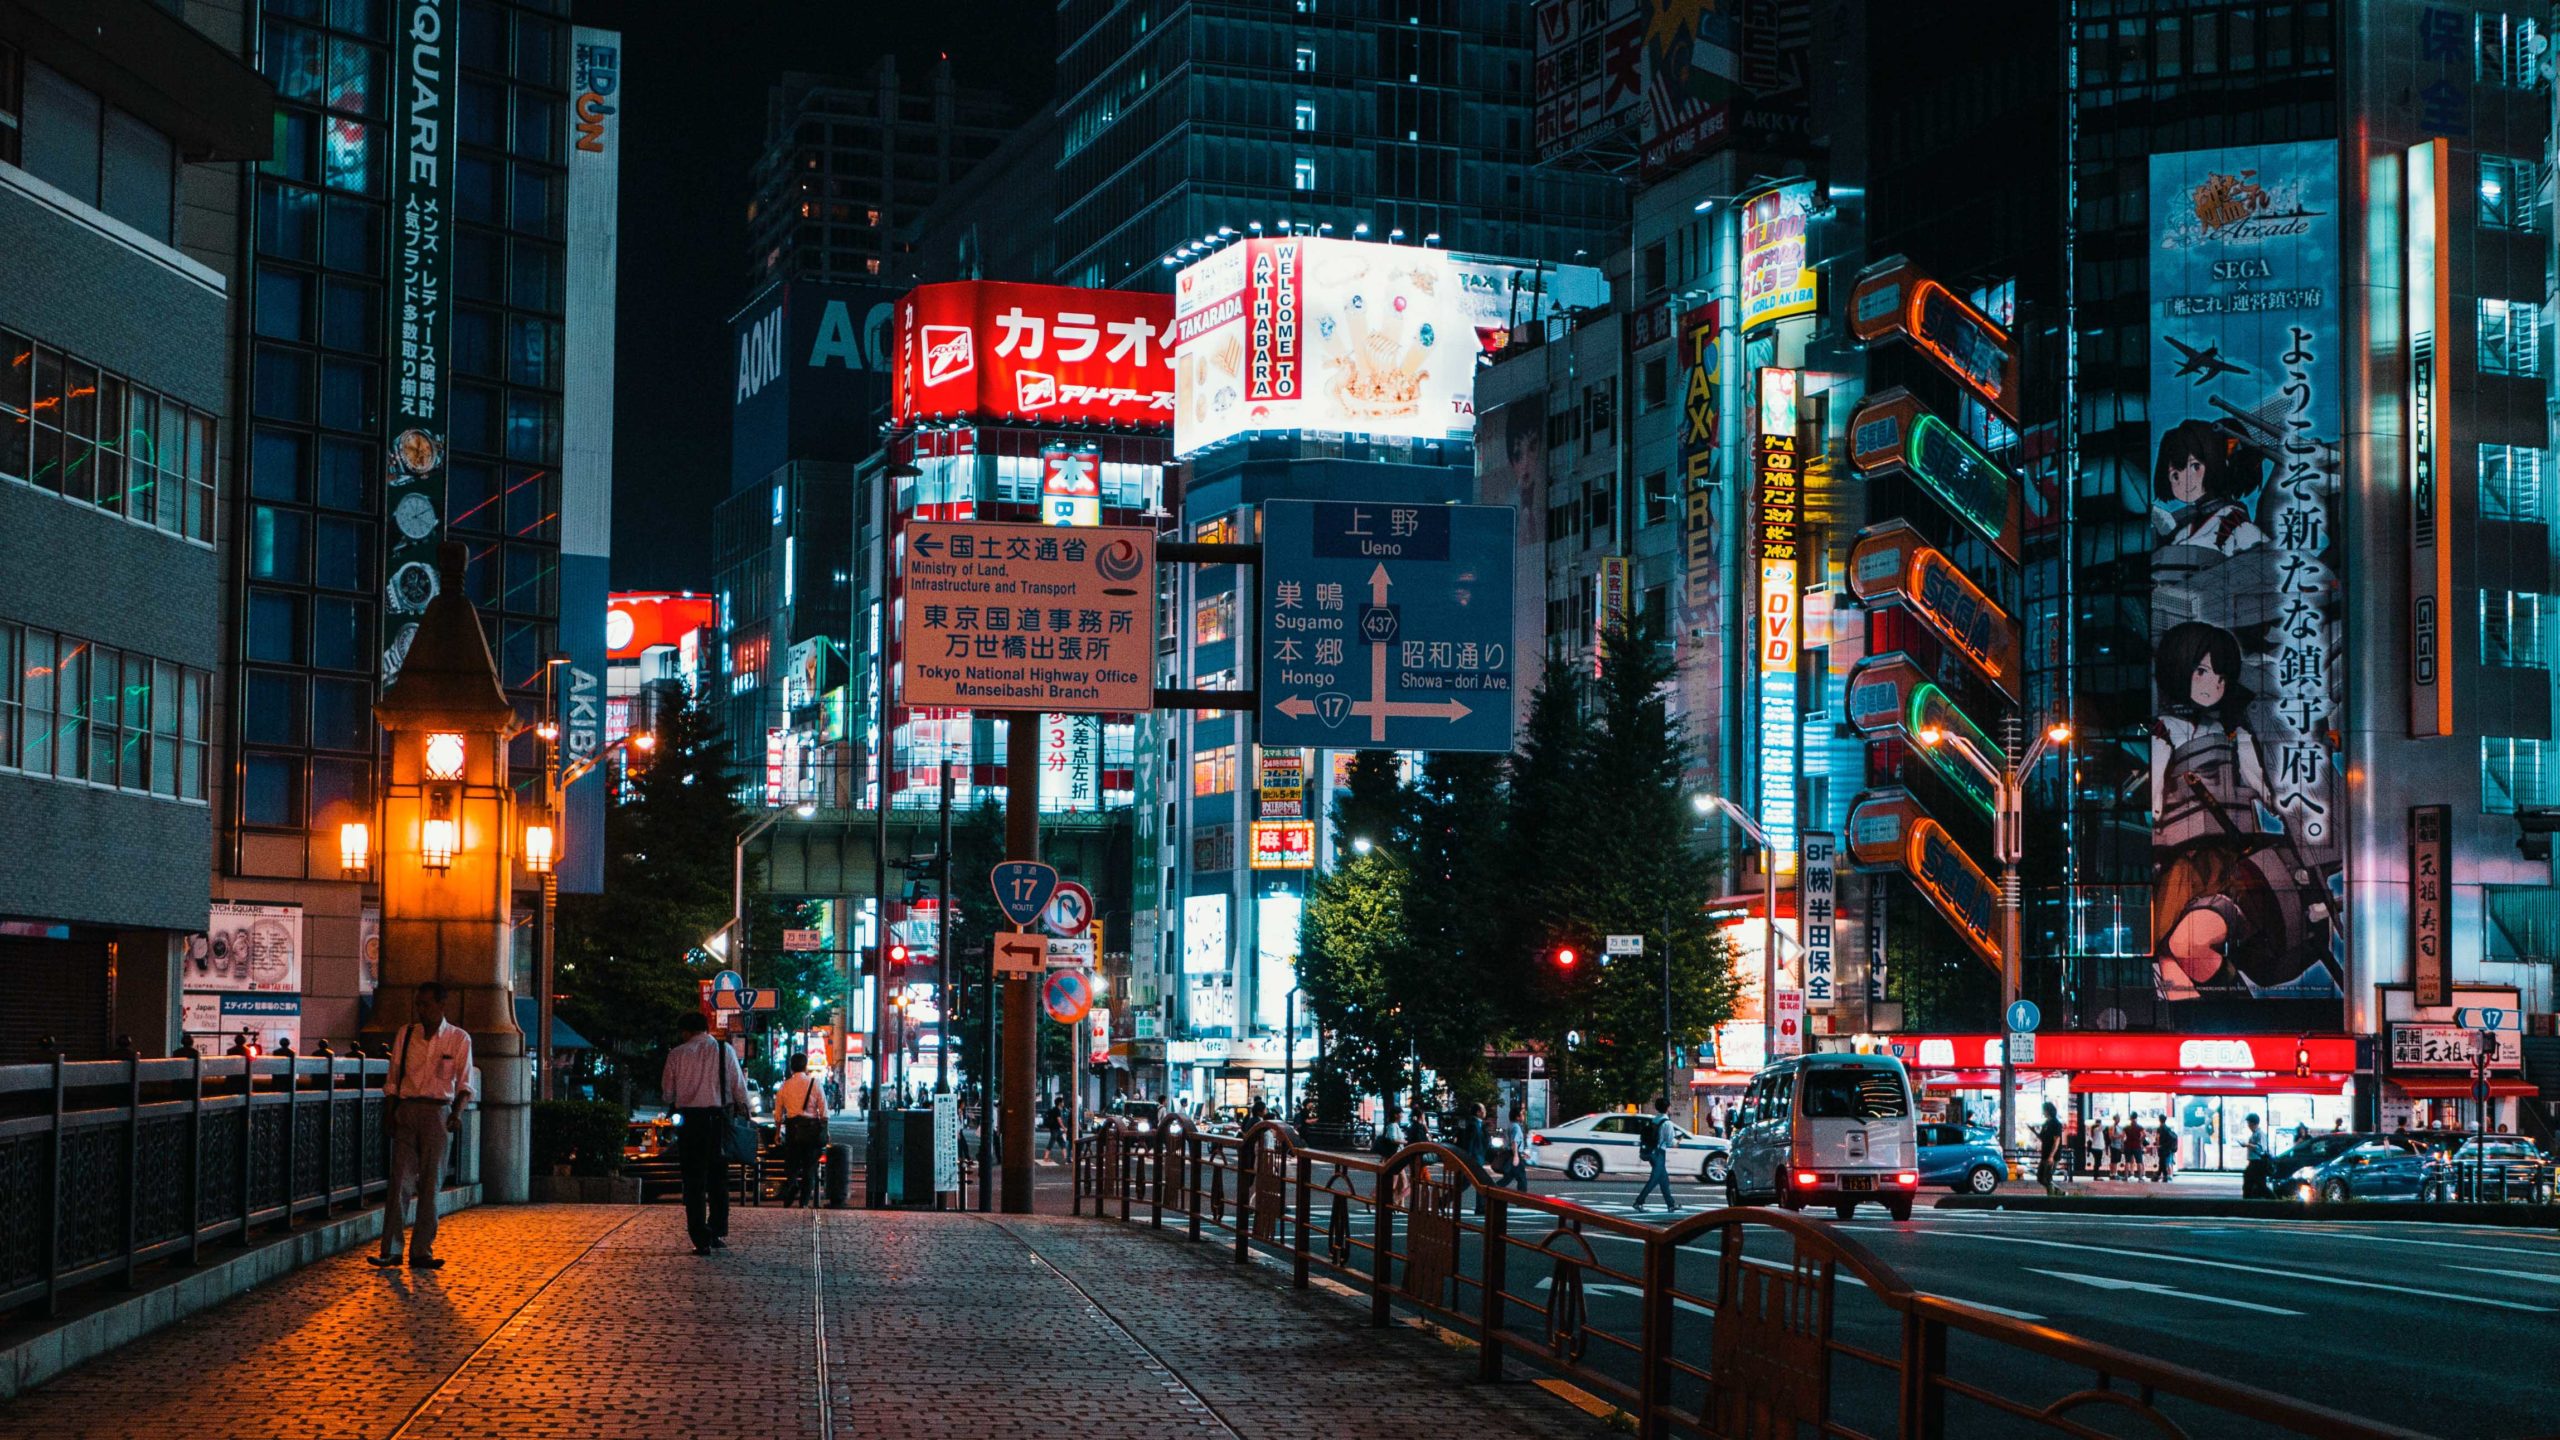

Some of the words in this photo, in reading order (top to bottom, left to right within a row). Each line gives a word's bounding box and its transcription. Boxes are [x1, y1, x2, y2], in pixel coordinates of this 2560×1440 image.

[409, 0, 441, 188] QUARE
[2209, 217, 2309, 241] Arcade
[2213, 259, 2271, 280] SEGA
[1278, 245, 1295, 354] WELCOME
[1179, 296, 1243, 341] TAKARADA
[1256, 255, 1270, 395] AKIHABARA
[737, 305, 782, 405] AOKI
[904, 303, 913, 420] カラオケ
[1279, 364, 1293, 394] TO
[1688, 323, 1712, 443] TAX
[1765, 436, 1794, 451] ゲーム
[1856, 416, 1898, 456] SEGA
[1767, 455, 1792, 469] CD
[1049, 456, 1096, 493] 本
[1764, 472, 1795, 487] アイドル
[1763, 489, 1795, 505] アニメ
[1344, 508, 1419, 537] 上野
[1764, 508, 1794, 523] コミック
[1687, 450, 1709, 609] FREE
[1766, 526, 1793, 541] ホビー
[950, 535, 1088, 562] 国土交通省
[1361, 540, 1402, 556] Ueno
[911, 562, 957, 577] Ministry
[962, 563, 974, 576] of
[977, 564, 1010, 578] Land,
[911, 579, 990, 593] Infrastructure
[995, 581, 1017, 594] and
[1021, 581, 1077, 597] Transport
[2278, 326, 2325, 838] ようこそ新たな鎮守府へ。
[1274, 581, 1344, 611] 巣鴨
[923, 605, 1134, 635] 東京国道事務所
[1274, 614, 1344, 632] Sugamo
[1367, 617, 1393, 633] 437
[1924, 563, 1992, 665] SEGA
[1767, 593, 1791, 662] DVD
[945, 634, 1111, 662] 万世橋出張所
[1273, 637, 1344, 666] 本郷
[1401, 640, 1505, 670] 昭和通り
[917, 664, 961, 681] Tokyo
[966, 666, 1025, 681] National
[1029, 667, 1089, 684] Highway
[1095, 669, 1138, 684] Office
[1281, 670, 1335, 687] Hongo
[1483, 675, 1510, 690] Ave.
[955, 682, 1045, 698] Manseibashi
[1049, 684, 1099, 699] Branch
[1856, 682, 1899, 716] SEGA
[1322, 698, 1343, 718] 17
[1260, 830, 1304, 850] 麻雀
[1806, 844, 1833, 861] 8F
[1010, 878, 1038, 901] 17
[232, 905, 264, 913] SQUARE
[1011, 903, 1034, 912] ROUTE
[2419, 853, 2438, 957] 元祖寿司
[1806, 868, 1833, 1000] (株)半田保全
[739, 992, 754, 1005] 17
[2486, 1011, 2500, 1025] 17
[1894, 1046, 1904, 1056] 17
[2182, 1041, 2252, 1067] SEGA
[2424, 1039, 2501, 1062] 元祖
